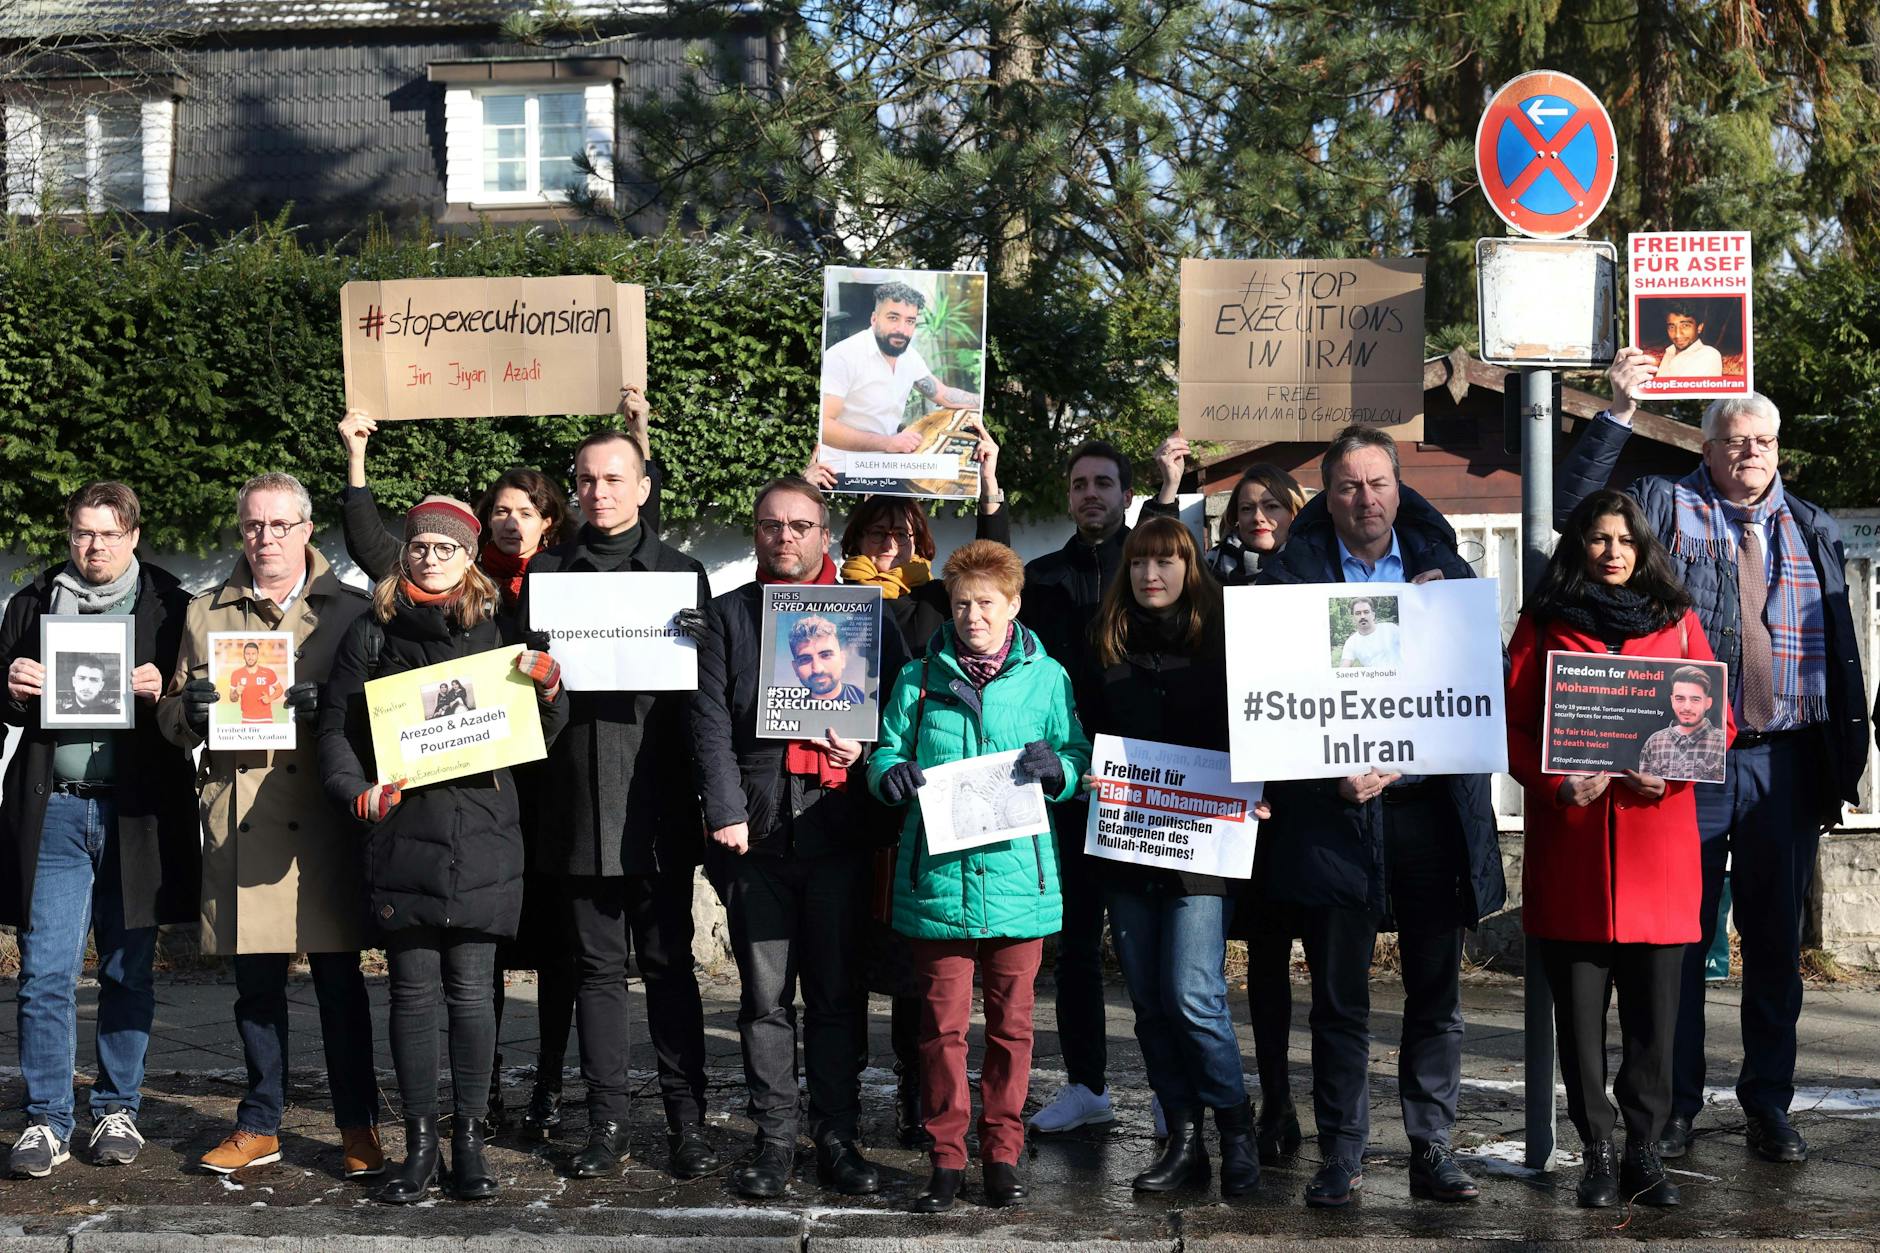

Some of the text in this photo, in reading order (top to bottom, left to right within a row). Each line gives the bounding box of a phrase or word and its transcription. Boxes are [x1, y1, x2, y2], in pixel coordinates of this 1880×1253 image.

[1633, 236, 1745, 253] FREIHEIT
[1633, 254, 1746, 272] FÜR ASEF
[1238, 270, 1357, 306] #STOP
[1634, 276, 1746, 288] SHAHBAKHSH
[358, 297, 612, 347] #stopexecutionsiran
[1215, 303, 1404, 335] EXECUTIONS
[1248, 339, 1378, 369] IN IRAN
[406, 364, 432, 386] Jin
[448, 361, 487, 390] Jiyan
[1267, 386, 1321, 402] FREE
[1200, 404, 1402, 424] MOHAMMAD GHOBADLOU
[855, 461, 880, 469] SALEH
[900, 462, 938, 470] HASHEMI
[880, 479, 897, 488] صالح
[773, 592, 791, 600] THIS
[772, 602, 872, 613] SEYED ALI MOUSAVI
[1336, 669, 1397, 680] Saeed Yaghoubi
[1556, 664, 1665, 681] Freedom for Mehdi
[767, 687, 810, 698] #STOP
[1556, 681, 1656, 698] Mohammadi Fard
[766, 698, 851, 711] EXECUTIONS
[1243, 687, 1491, 727] #StopExecution
[1554, 703, 1568, 711] Only
[1576, 704, 1590, 712] years
[1602, 705, 1626, 713] Tortured
[1626, 706, 1637, 714] and
[1637, 707, 1656, 715] beaten
[1657, 708, 1664, 716] by
[766, 709, 781, 720] IN
[1554, 711, 1576, 719] security
[1576, 711, 1592, 719] forces
[1602, 713, 1624, 721] months.
[400, 709, 506, 742] Arezoo & Azadeh
[765, 720, 799, 731] IRAN
[1553, 727, 1637, 740] No fair trial, sentenced
[420, 729, 490, 754] Pourzamad
[1553, 738, 1609, 749] to death twice!
[1552, 755, 1614, 767] #StopExecutionsNow
[1103, 760, 1186, 786] Freiheit für
[1100, 782, 1242, 818] Elahe Mohammadi
[1099, 807, 1213, 834] und alle politischen
[1098, 820, 1189, 845] Gefangenen des
[1097, 833, 1195, 861] Mullah-Regimes!
